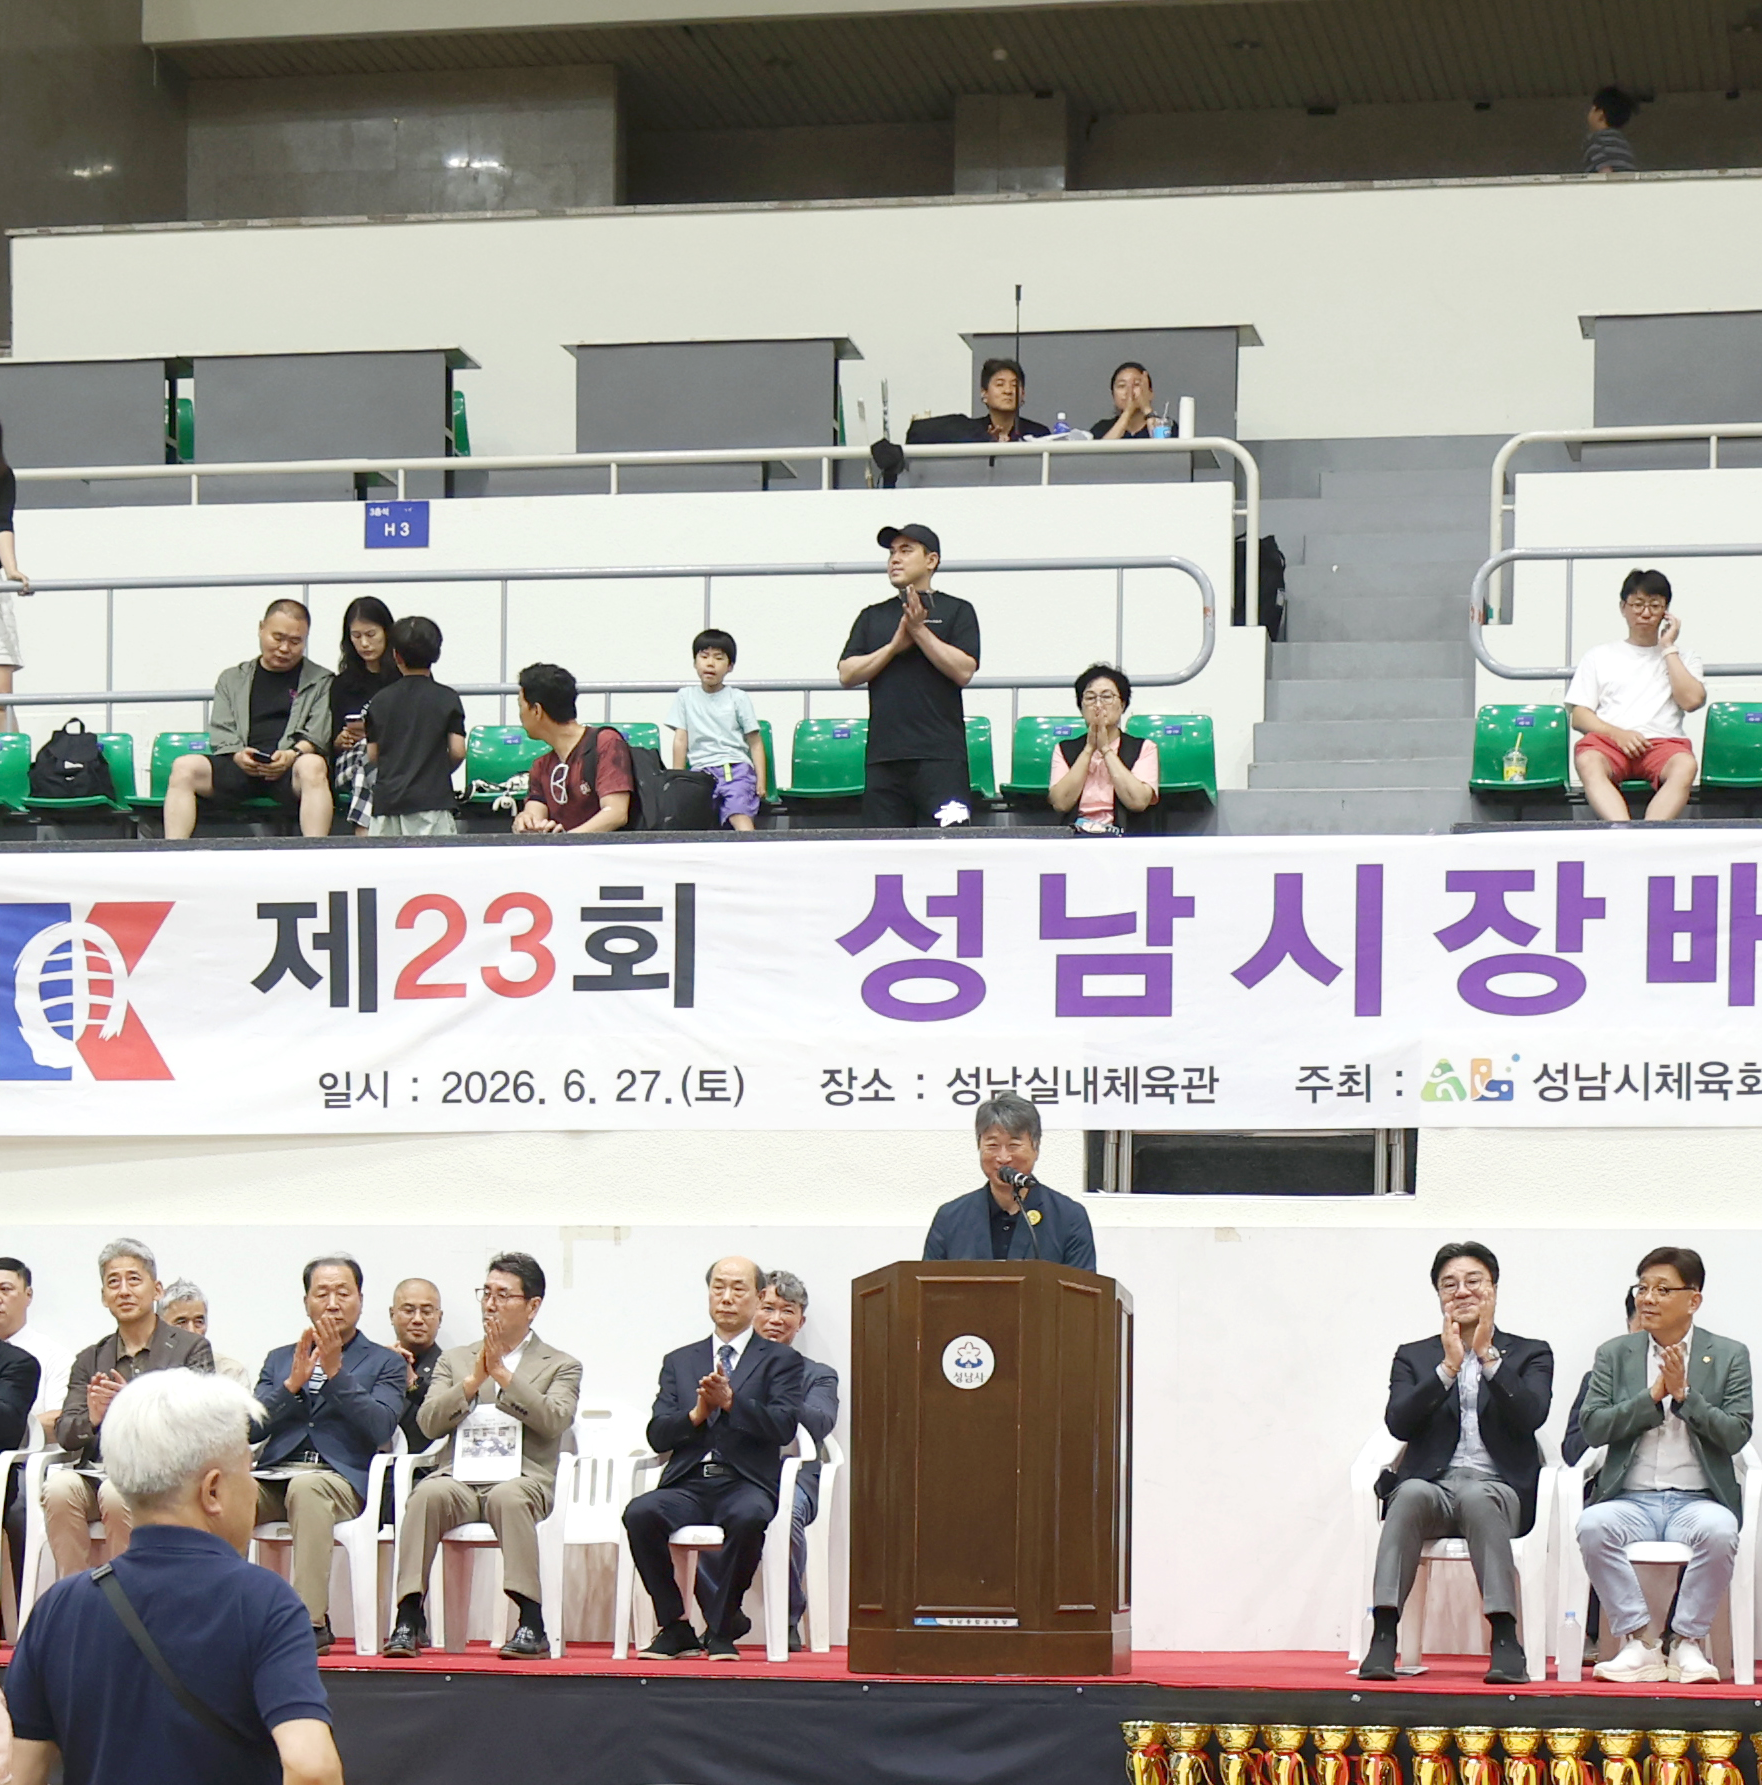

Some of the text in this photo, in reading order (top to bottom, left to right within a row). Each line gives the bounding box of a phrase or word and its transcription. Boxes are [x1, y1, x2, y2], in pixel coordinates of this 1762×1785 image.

[384, 522, 410, 537] H 3
[250, 883, 696, 1013] 제23회
[318, 1070, 390, 1109] 일시
[441, 1070, 546, 1106] 2026.
[563, 1070, 596, 1106] 6.
[820, 1067, 896, 1106] 장소
[945, 1065, 1220, 1106] 성남실내체육관
[1294, 1064, 1372, 1104] 주최
[953, 1372, 984, 1384] 성남시
